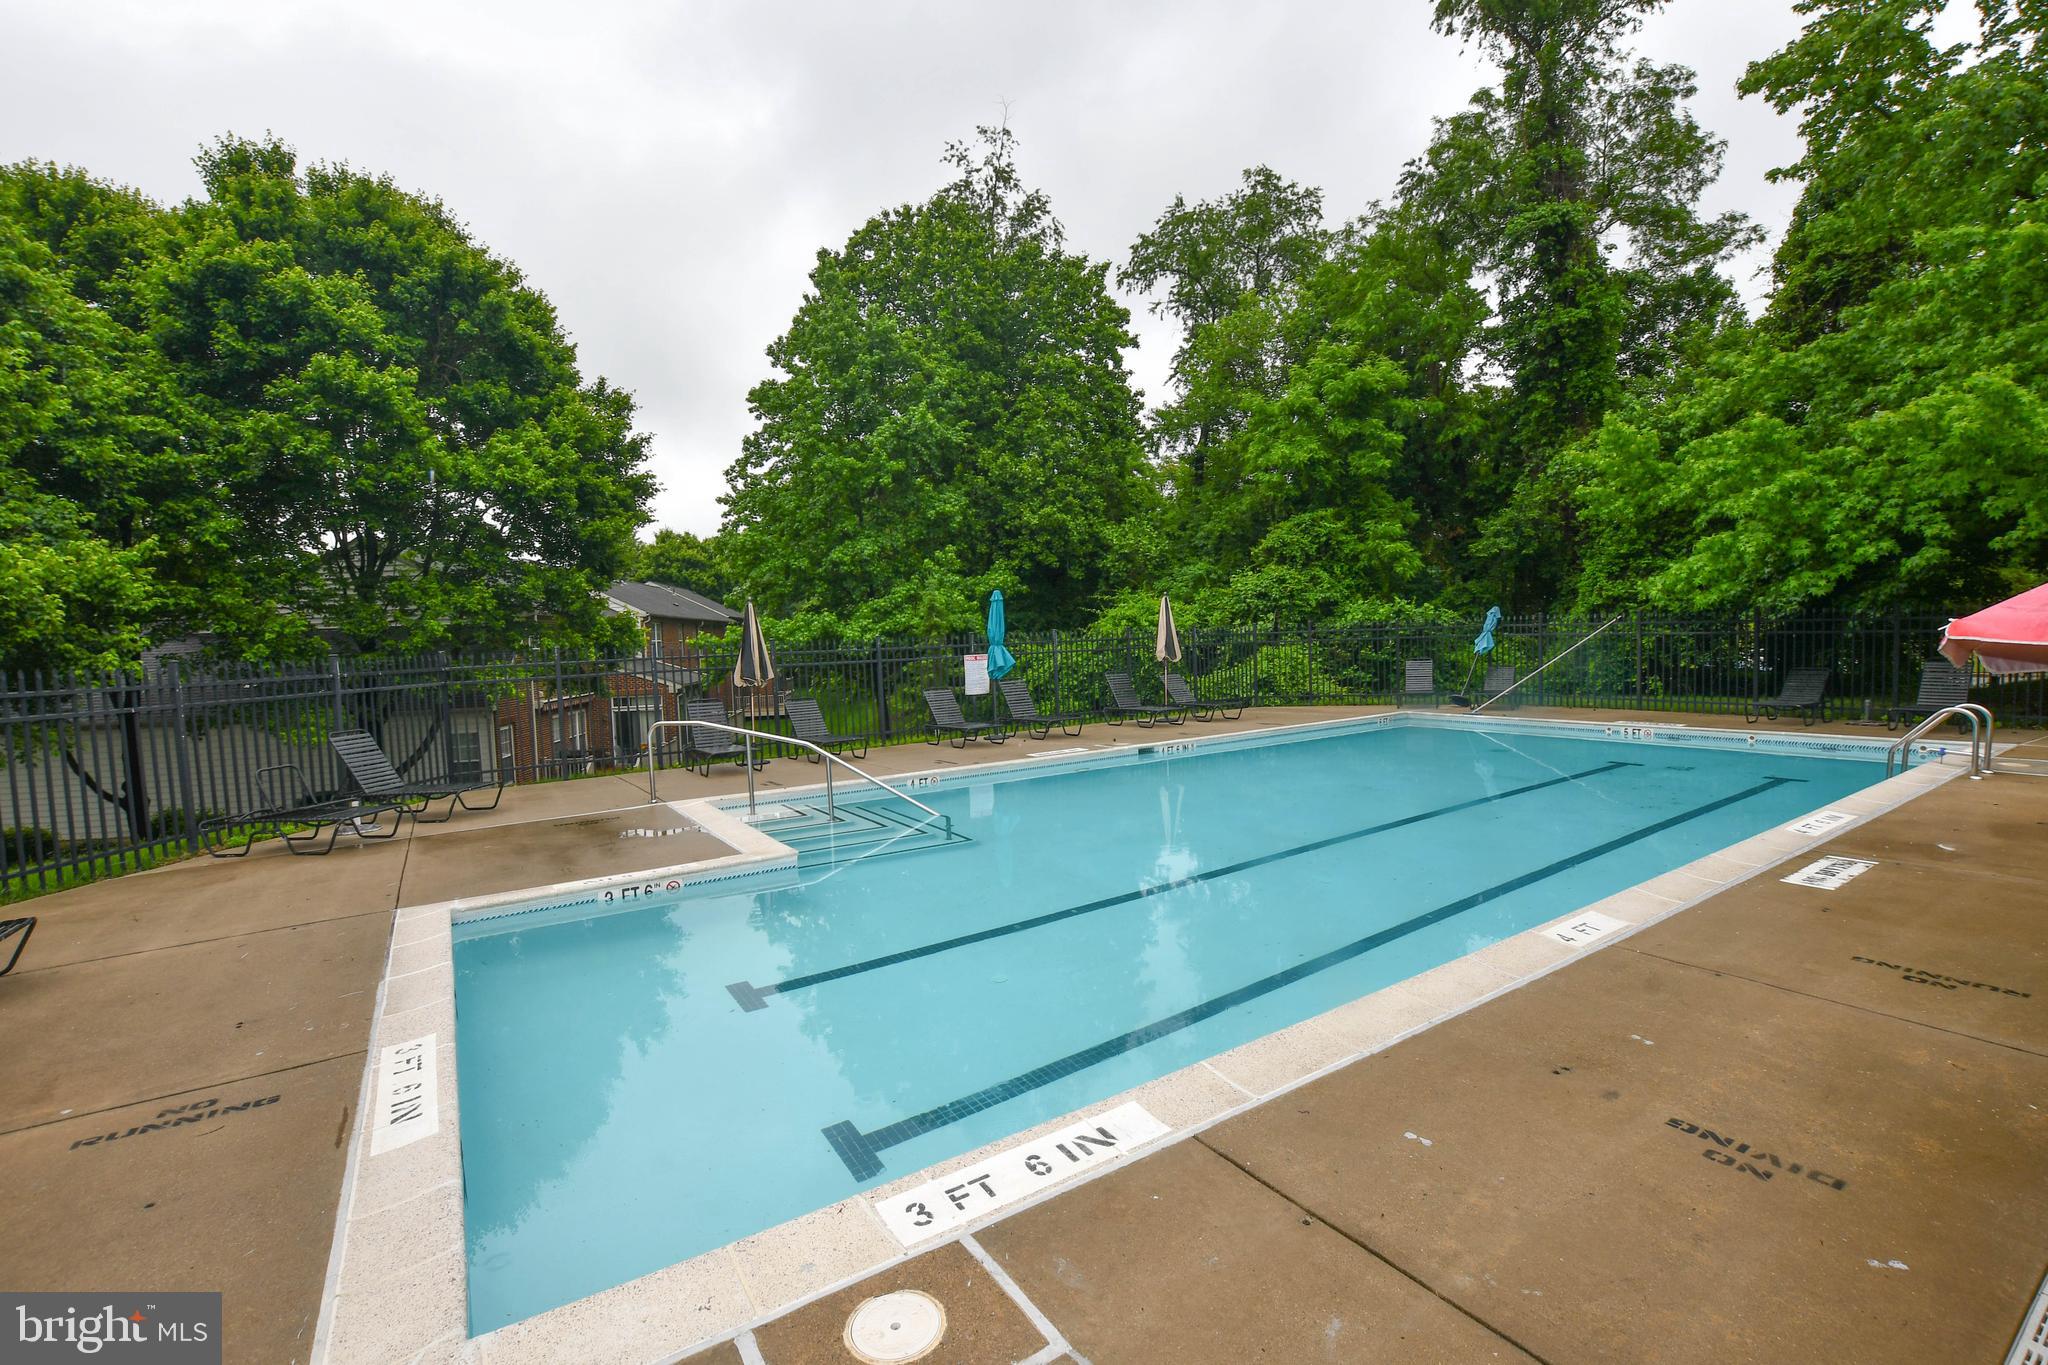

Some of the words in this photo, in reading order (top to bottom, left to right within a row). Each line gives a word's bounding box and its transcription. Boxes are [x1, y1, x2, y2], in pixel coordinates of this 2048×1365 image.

[604, 890, 614, 904] 3
[621, 886, 640, 902] FT
[644, 884, 654, 897] 6
[1556, 933, 1577, 942] 4
[1571, 922, 1601, 936] FT
[1850, 955, 2033, 999] RUNNING
[1902, 974, 1958, 991] NO
[69, 1094, 282, 1151] RUNNING
[156, 1098, 220, 1119] NO
[390, 1095, 424, 1126] IN
[1665, 1117, 1848, 1192] DIVING
[1701, 1148, 1774, 1182] NO
[905, 1202, 934, 1227] 3
[944, 1173, 997, 1211] FT
[1024, 1154, 1053, 1176] 6
[1055, 1126, 1119, 1163] IN
